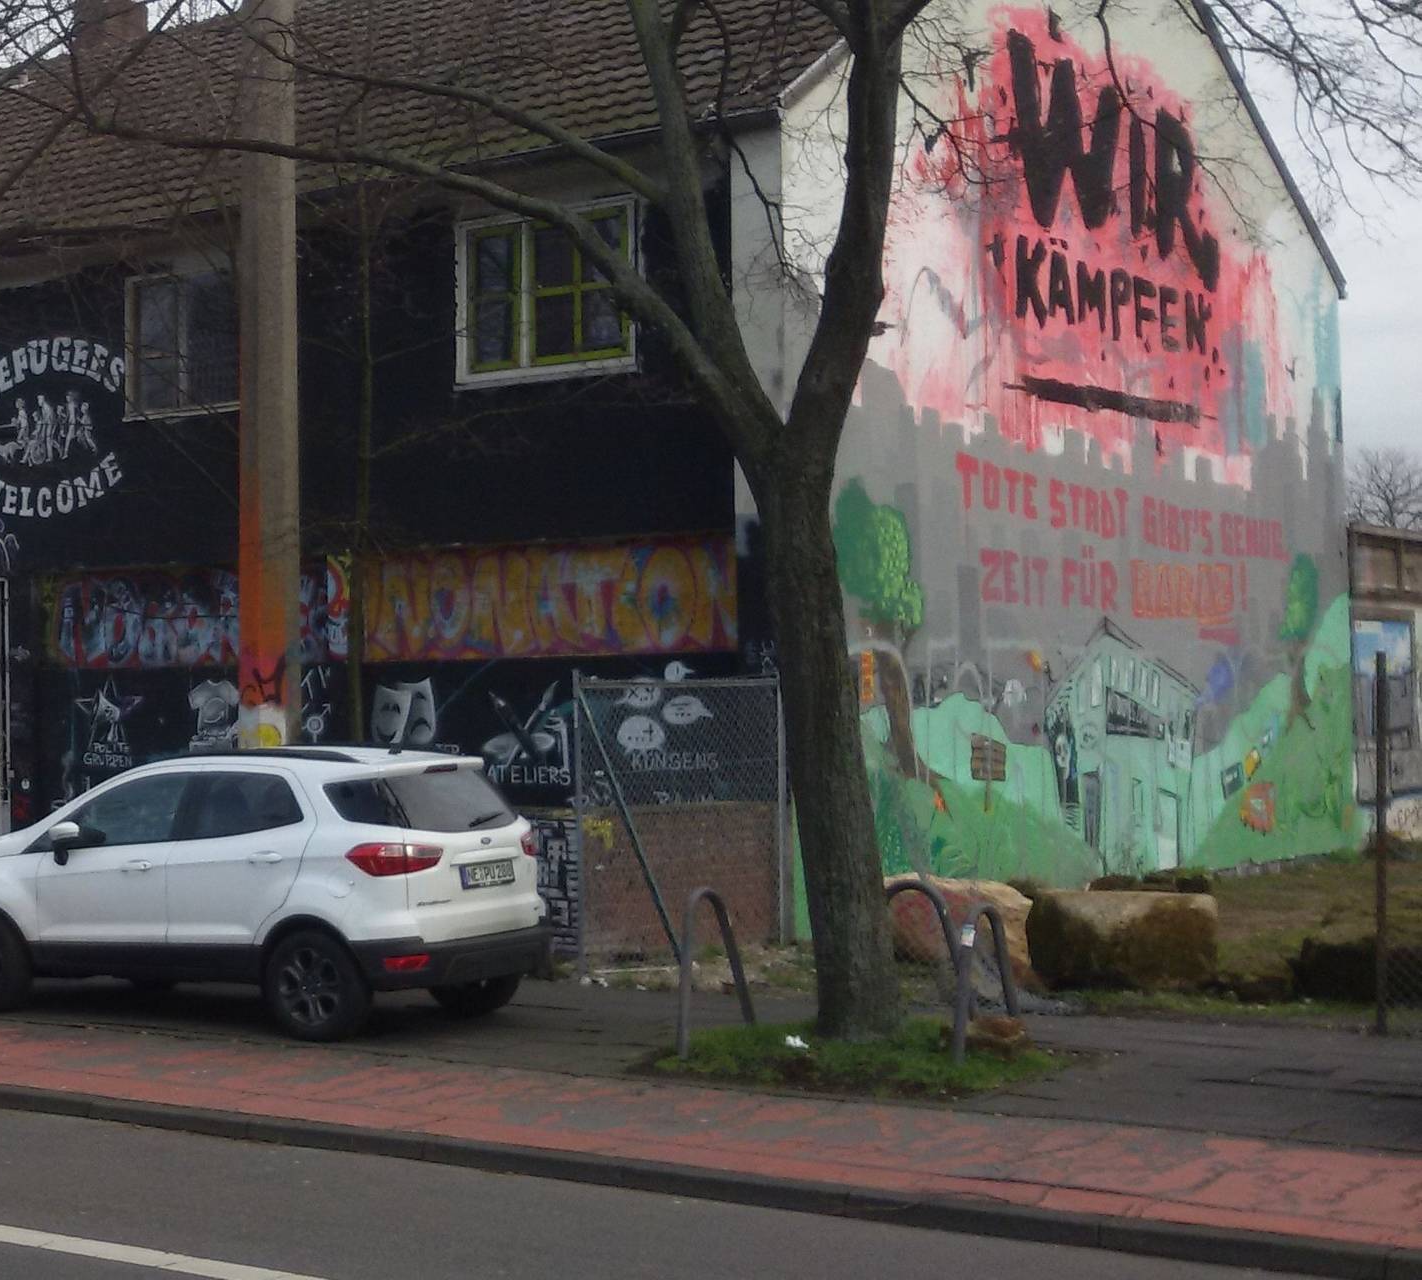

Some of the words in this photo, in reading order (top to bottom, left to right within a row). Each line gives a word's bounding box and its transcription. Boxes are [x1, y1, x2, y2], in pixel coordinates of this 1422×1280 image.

[1006, 28, 1219, 292] WIR
[1015, 234, 1212, 355] KÄMPFEN
[955, 451, 1038, 520] TOTE
[1049, 478, 1128, 540] STADT
[980, 547, 1048, 608] ZEIT
[1060, 545, 1119, 613] FÜR
[487, 765, 572, 786] ATELIERS
